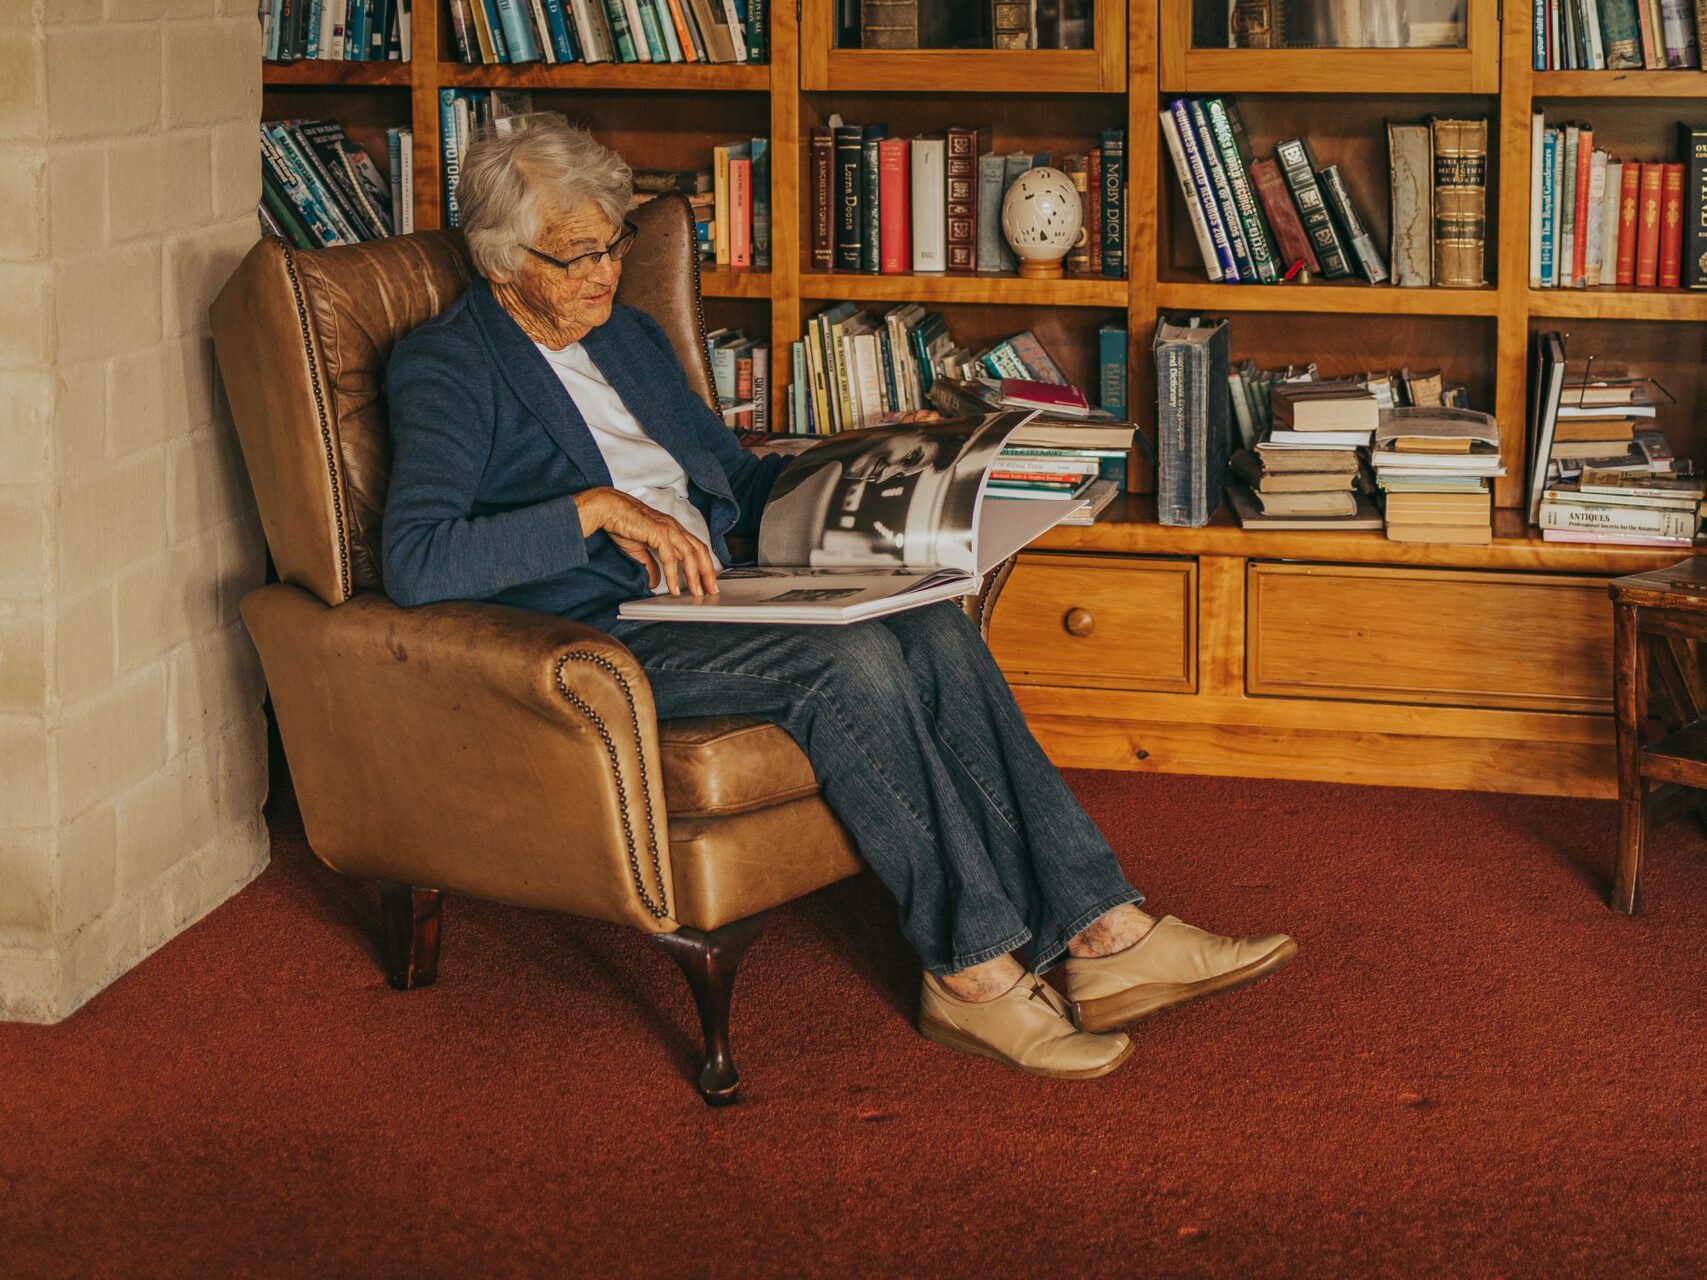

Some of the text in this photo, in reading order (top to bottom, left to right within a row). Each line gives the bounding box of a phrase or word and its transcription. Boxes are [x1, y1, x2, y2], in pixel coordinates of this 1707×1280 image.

[1536, 7, 1543, 16] to
[1536, 35, 1545, 55] your
[1174, 107, 1199, 154] GUINNESS
[1193, 109, 1206, 127] THE
[1197, 125, 1219, 166] GUINNESS
[1221, 147, 1242, 178] WORLD
[1188, 152, 1209, 186] WORLD
[1210, 165, 1225, 189] BOOK
[844, 162, 857, 230] Lorna Doone
[1106, 163, 1119, 244] MOBY DICK
[1197, 183, 1222, 226] RECORDS
[1217, 187, 1228, 201] OF
[1231, 177, 1254, 217] RECORDS
[1542, 148, 1556, 236] The Royal Gardeners
[818, 206, 827, 237] TOWERS
[1220, 199, 1240, 238] RECORDS
[1211, 224, 1228, 250] 2001
[1243, 216, 1268, 258] 2002
[753, 374, 763, 401] STORY
[1168, 367, 1177, 407] Dictionary
[1568, 511, 1610, 522] ANTIQUES
